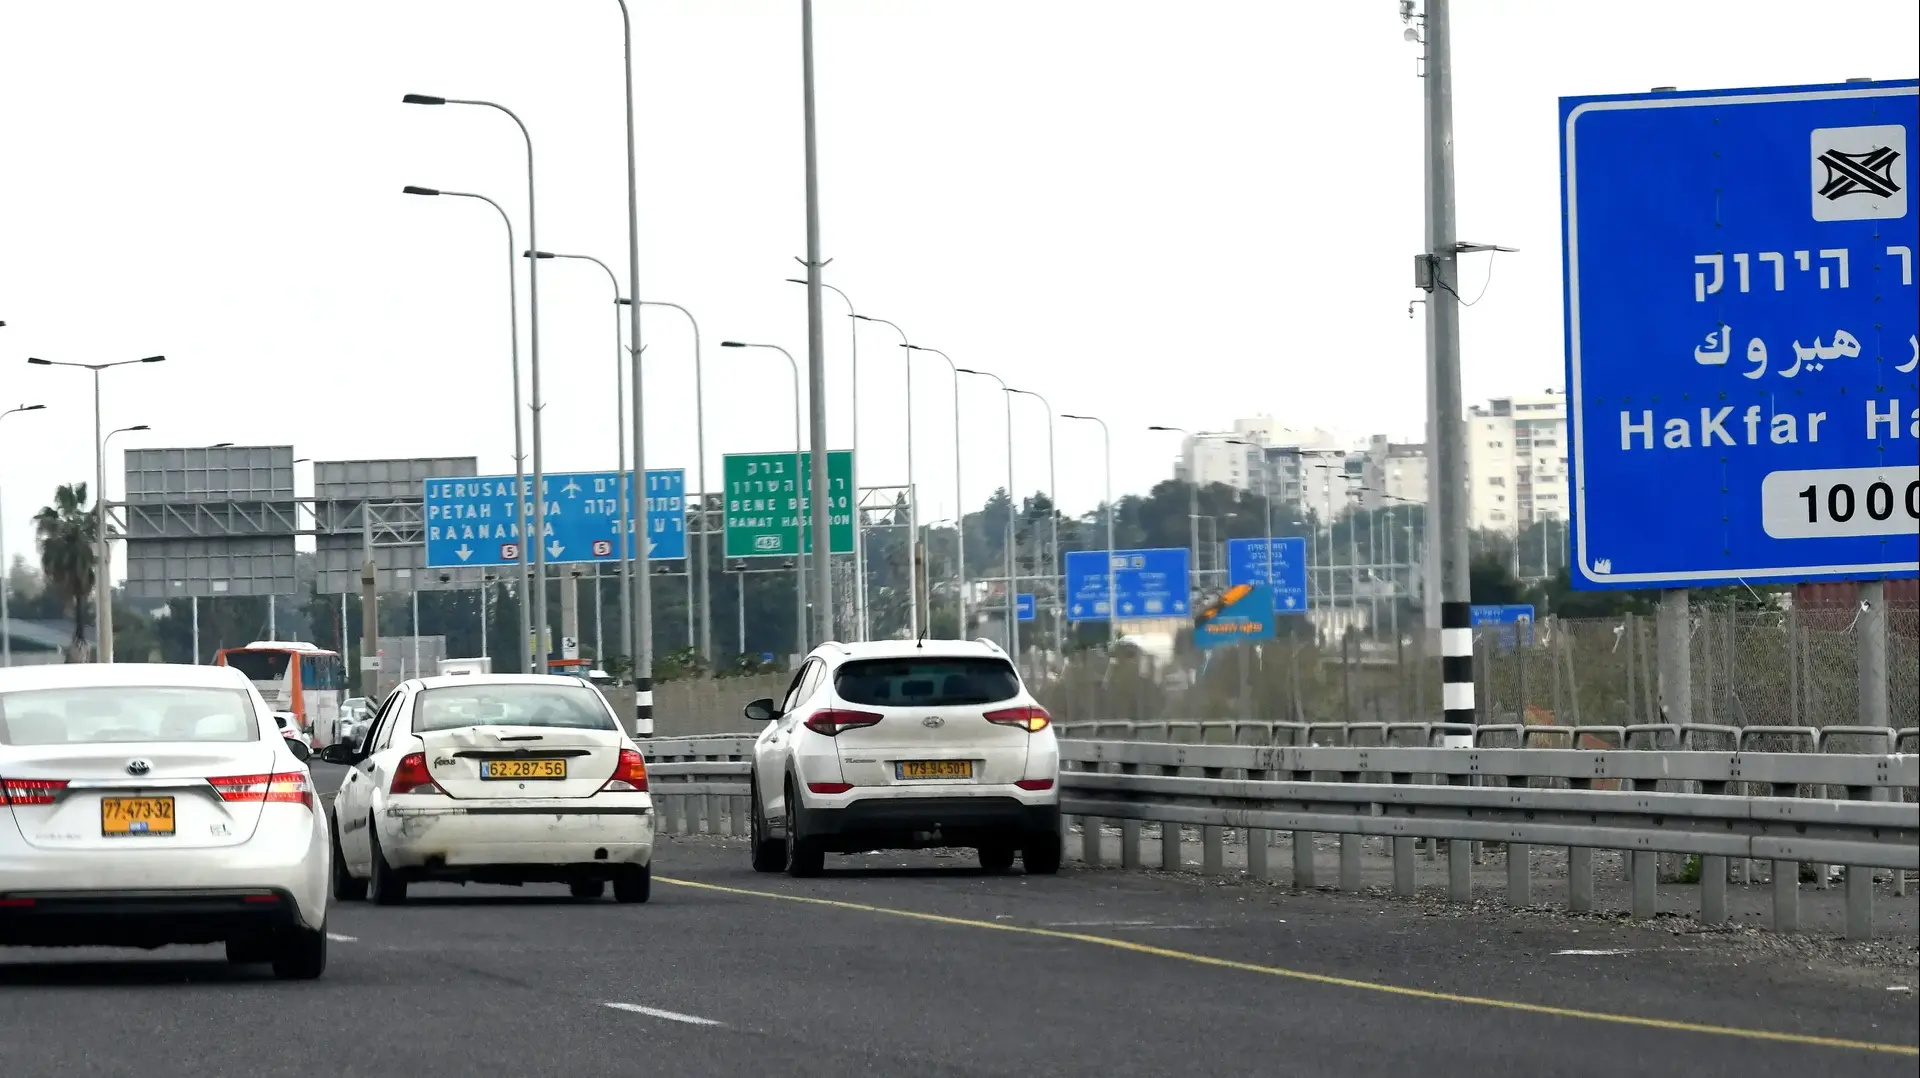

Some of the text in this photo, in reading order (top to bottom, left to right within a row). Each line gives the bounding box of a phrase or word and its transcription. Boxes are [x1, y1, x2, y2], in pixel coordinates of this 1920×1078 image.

[1694, 247, 1850, 303] הירוק
[1619, 404, 1828, 451] HaKfar
[747, 461, 784, 476] ברק
[593, 476, 681, 493] ירוים
[732, 479, 794, 495] השרון
[429, 501, 561, 520] PETAH TQA
[584, 498, 629, 516] קוה
[730, 496, 847, 512] BENE BEAQ
[611, 517, 682, 534] רענה
[728, 514, 850, 528] RAMAT HASRON
